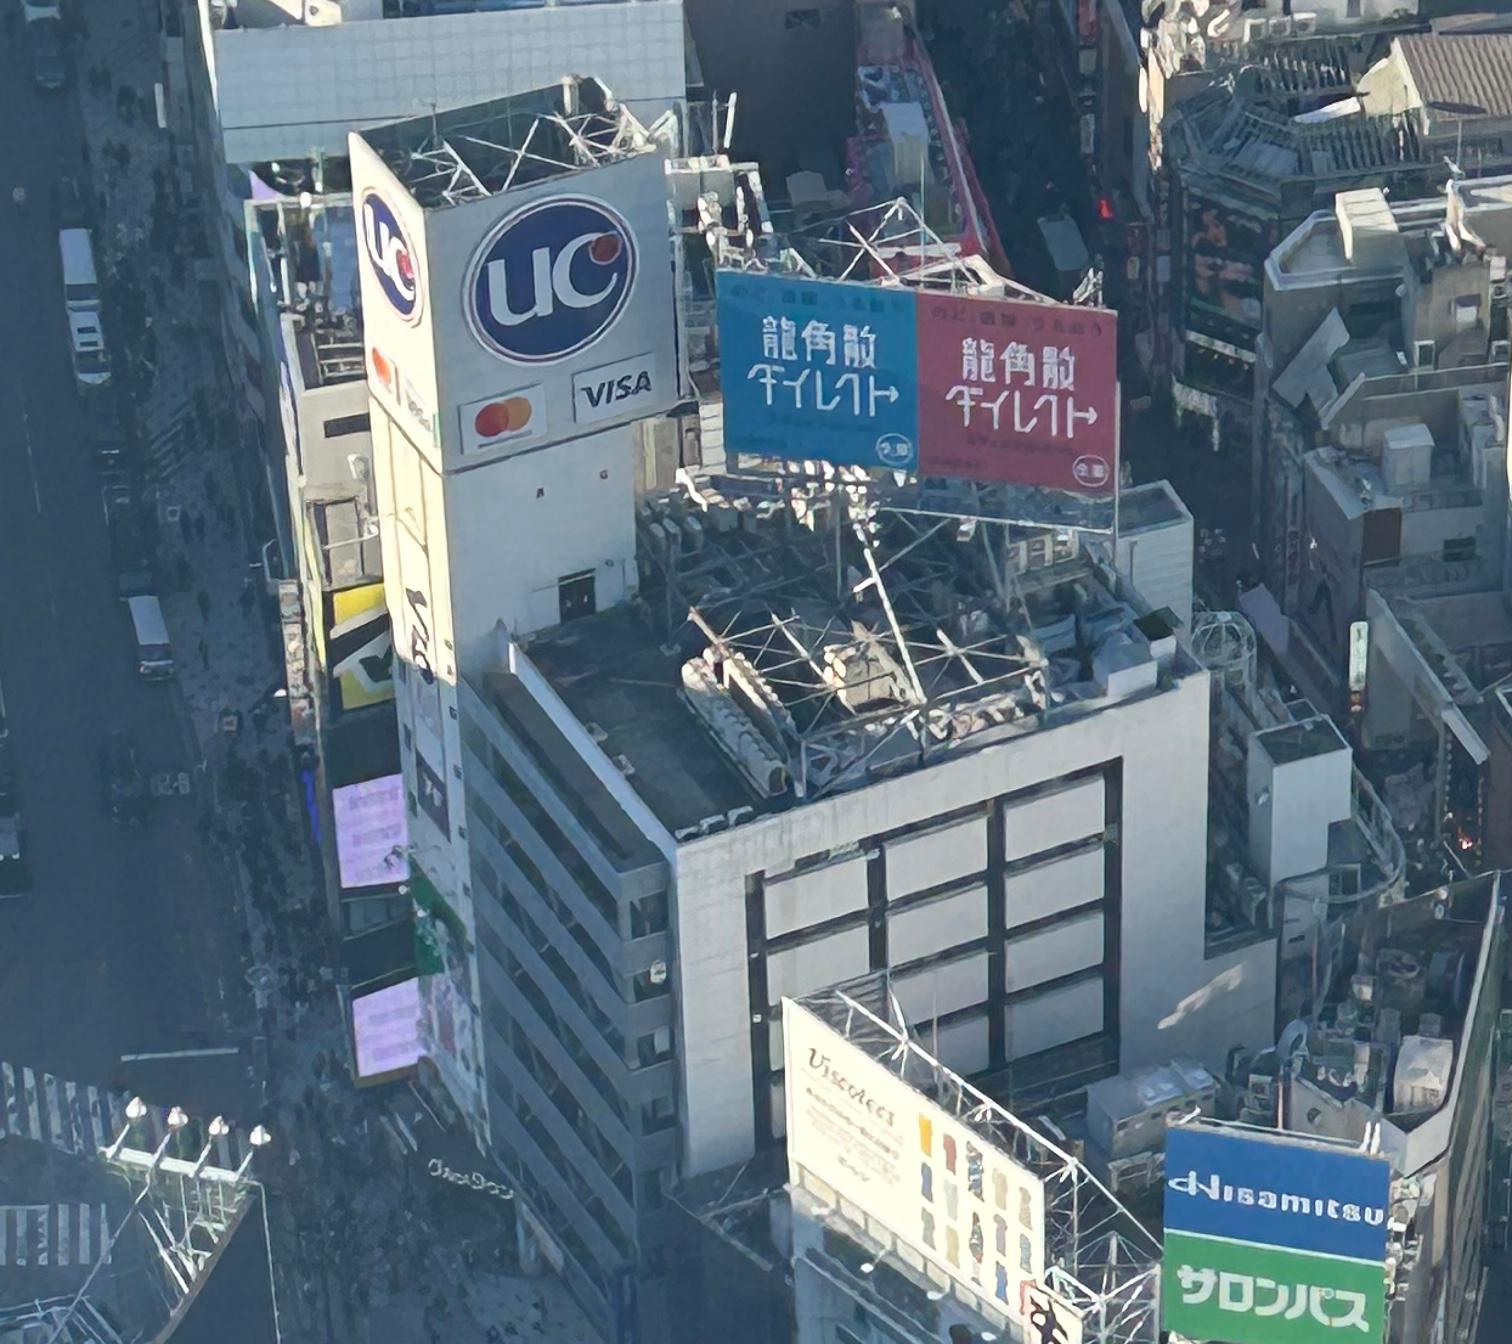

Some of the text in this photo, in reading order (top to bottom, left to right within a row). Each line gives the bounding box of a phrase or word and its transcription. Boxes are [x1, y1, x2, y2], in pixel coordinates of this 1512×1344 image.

[484, 231, 624, 326] UC
[762, 315, 877, 370] 龍角散
[961, 336, 1076, 392] 龍角散
[581, 370, 653, 408] VISA
[1167, 1170, 1384, 1227] Hisamitsu
[1176, 1263, 1370, 1333] サロンパス
